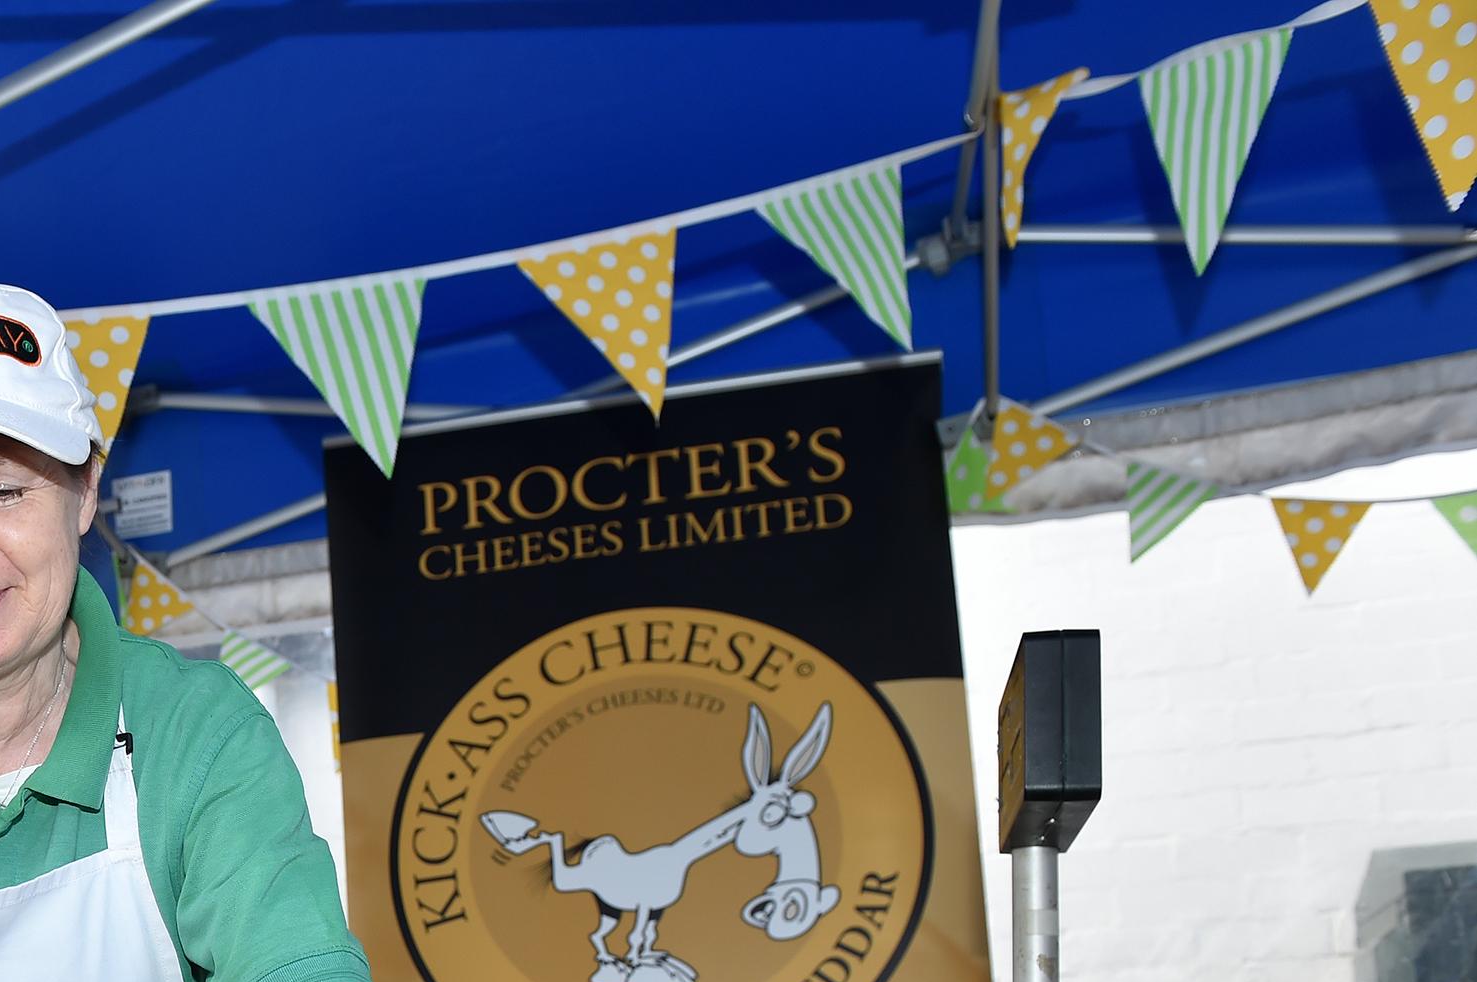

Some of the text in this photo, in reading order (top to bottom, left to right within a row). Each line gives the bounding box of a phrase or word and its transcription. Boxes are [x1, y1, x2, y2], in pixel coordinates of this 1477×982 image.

[418, 427, 847, 536] PROCTER'S
[418, 493, 854, 582] CHEESES LIMITED
[586, 686, 680, 718] CHEESES
[683, 688, 725, 715] LTD
